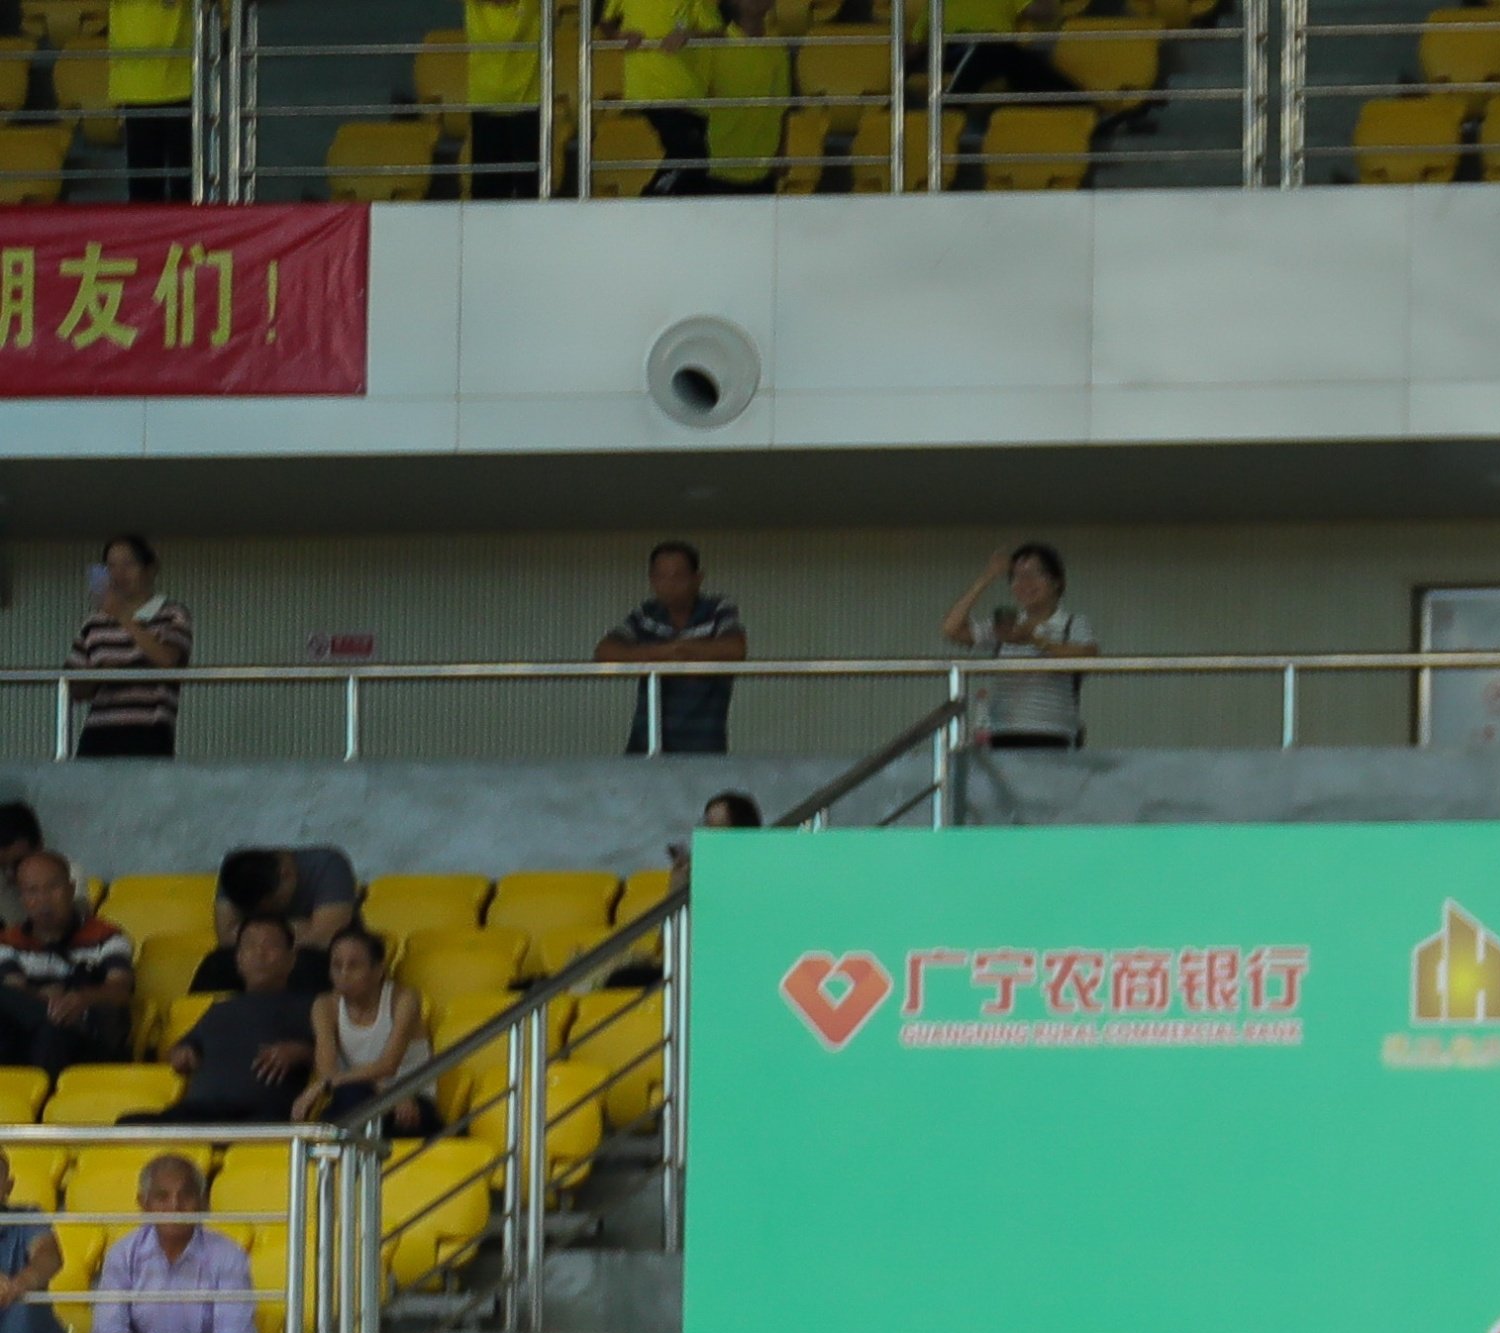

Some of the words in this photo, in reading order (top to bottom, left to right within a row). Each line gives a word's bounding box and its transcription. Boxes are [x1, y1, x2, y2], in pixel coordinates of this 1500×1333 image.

[901, 944, 1309, 1017] 广宁农商银行
